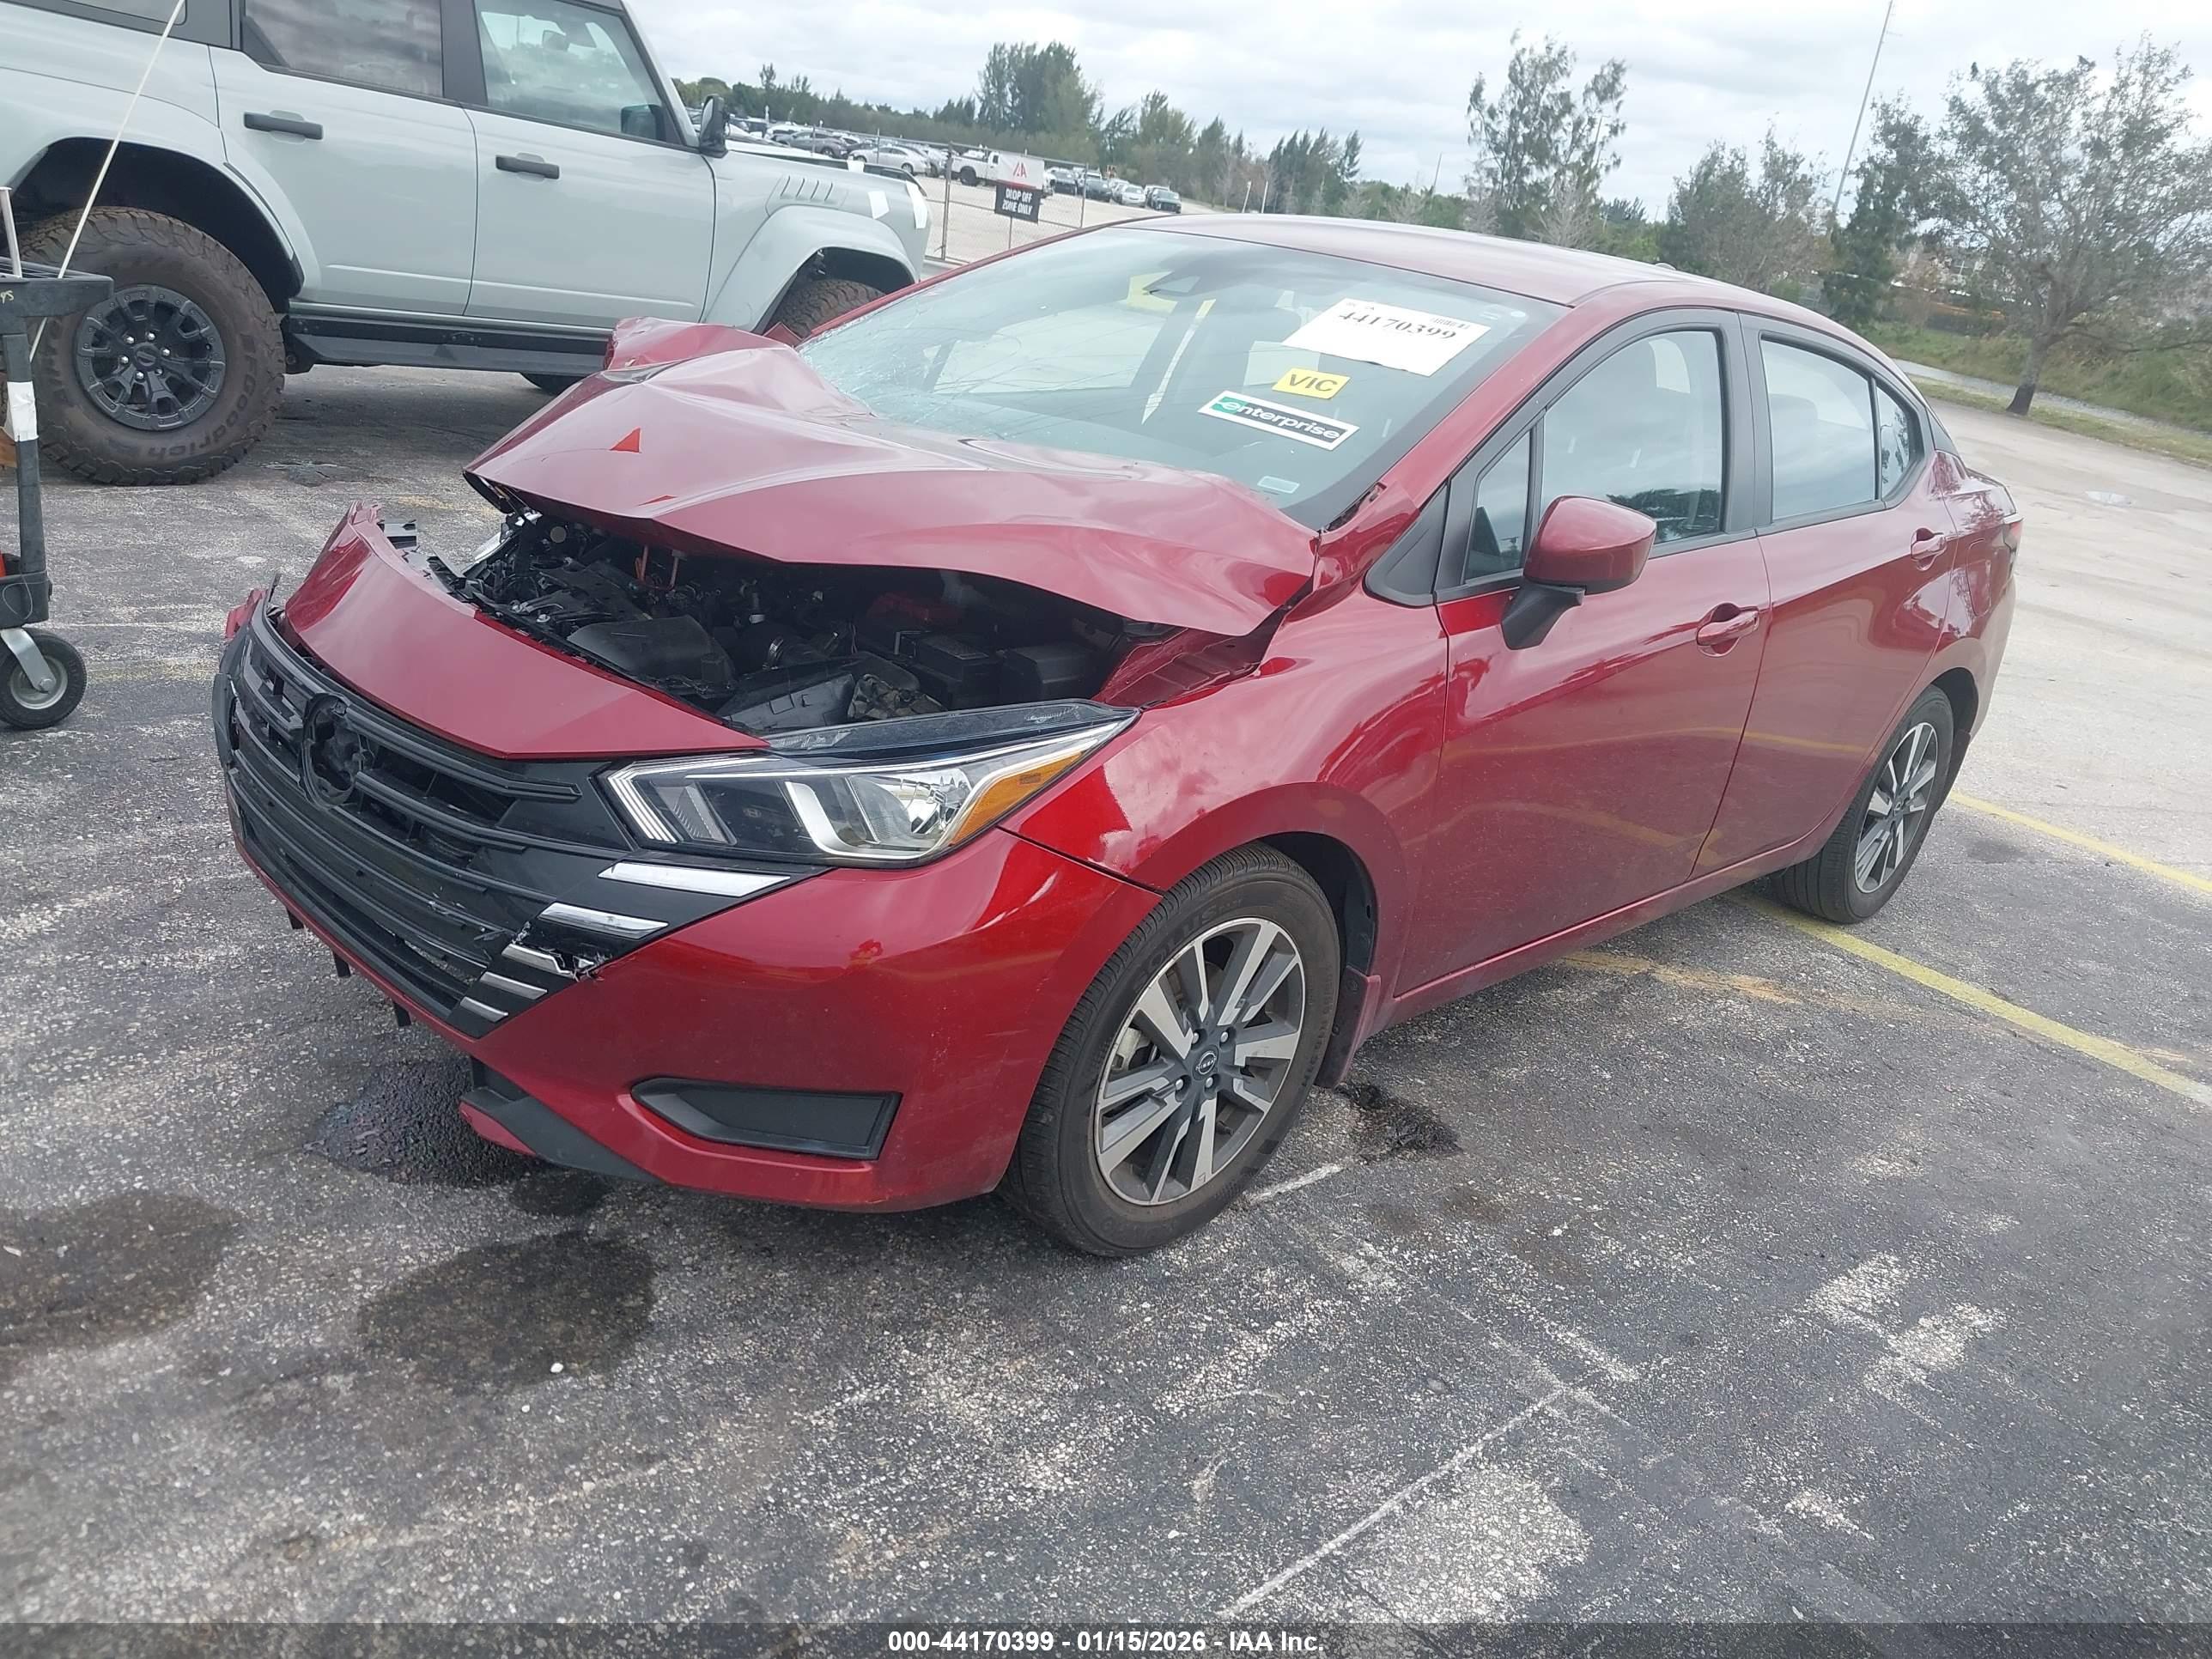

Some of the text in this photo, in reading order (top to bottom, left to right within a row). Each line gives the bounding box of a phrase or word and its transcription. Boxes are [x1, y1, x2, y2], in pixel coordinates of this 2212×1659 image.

[1006, 188, 1033, 203] DROP OFF
[1002, 198, 1033, 216] ZONE ONLY
[1340, 312, 1457, 339] 44170399
[1288, 374, 1339, 393] VIC
[1216, 398, 1341, 441] enterprise
